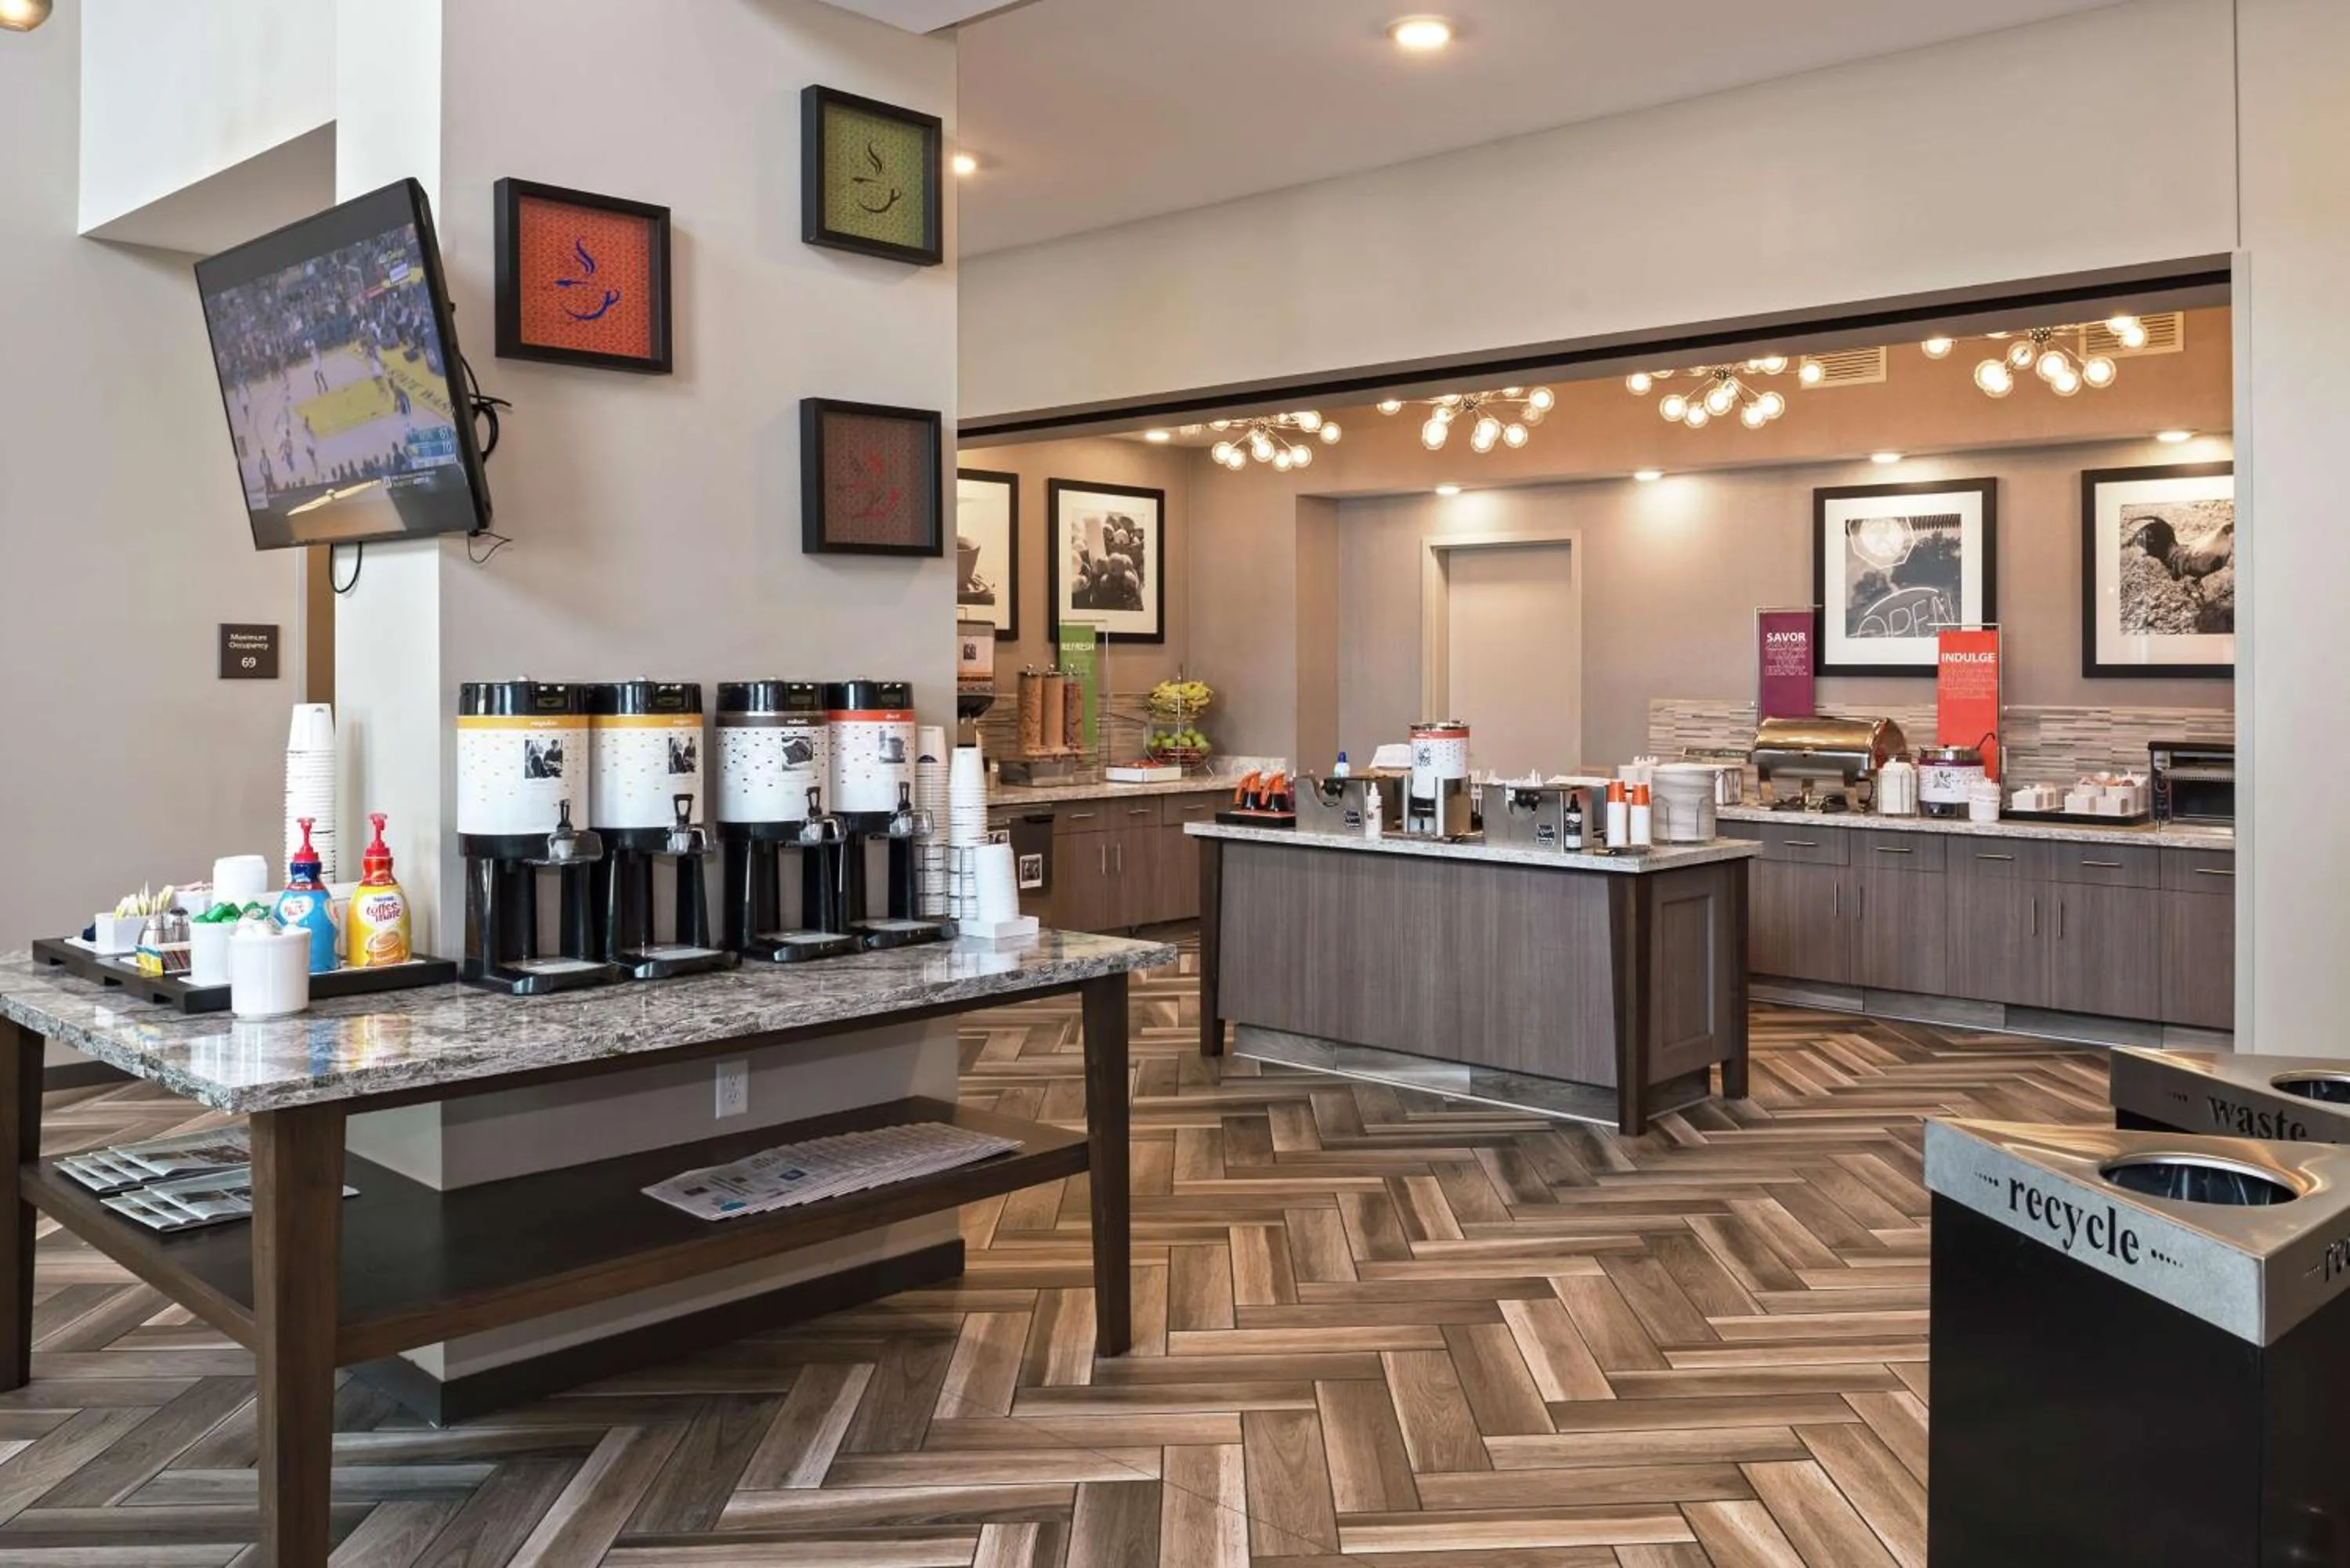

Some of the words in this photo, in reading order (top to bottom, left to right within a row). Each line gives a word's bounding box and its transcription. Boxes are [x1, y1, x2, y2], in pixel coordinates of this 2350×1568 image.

[1766, 632, 1806, 642] SAVOR
[241, 657, 256, 668] 69
[1941, 652, 1997, 663] INDULGE
[2207, 1095, 2307, 1140] waste
[2008, 1176, 2139, 1265] recycle
